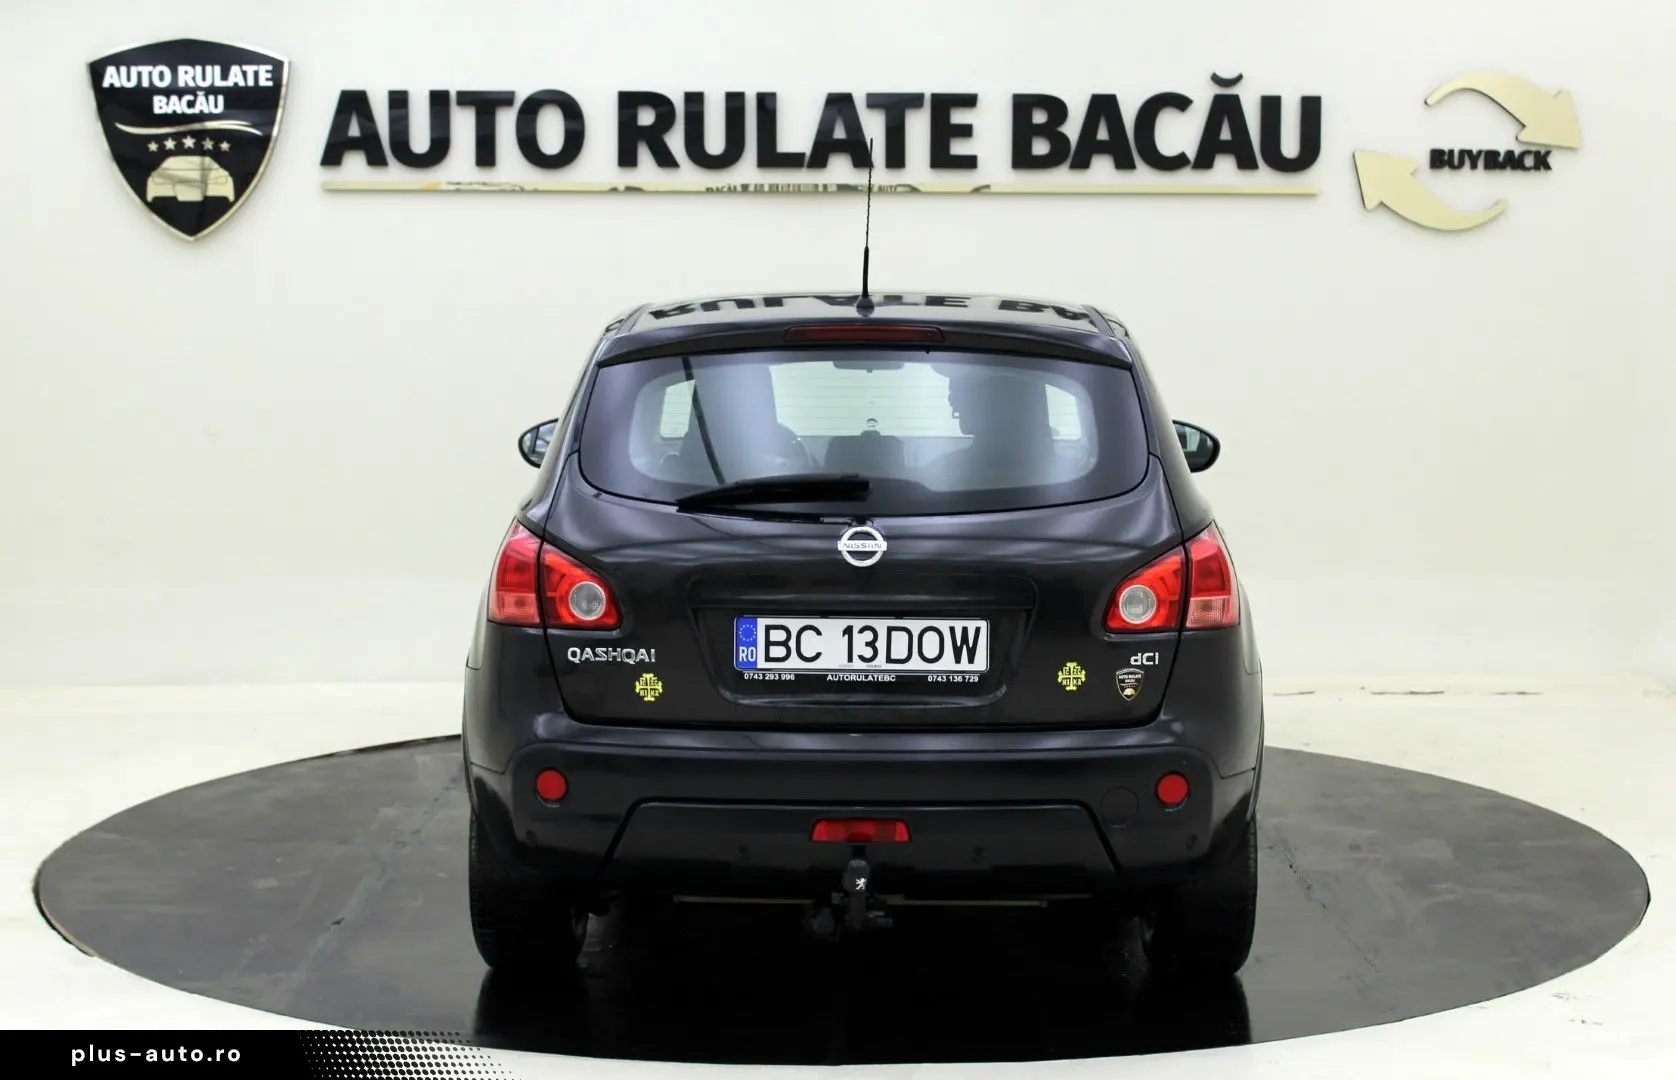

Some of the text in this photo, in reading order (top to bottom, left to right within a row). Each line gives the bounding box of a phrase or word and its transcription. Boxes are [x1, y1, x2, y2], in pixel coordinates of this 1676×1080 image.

[102, 65, 273, 88] AUTO RULATE
[152, 90, 224, 115] BACĂU
[319, 72, 1322, 172] AUTO RULATE BACĂU
[1429, 148, 1552, 171] BUYBACK
[764, 624, 823, 662] BC
[567, 647, 656, 664] QASHQAI
[739, 647, 756, 662] RO
[781, 673, 796, 681] 996
[826, 674, 897, 682] AUTORULATEBC
[949, 675, 963, 683] 136
[965, 675, 979, 683] 729
